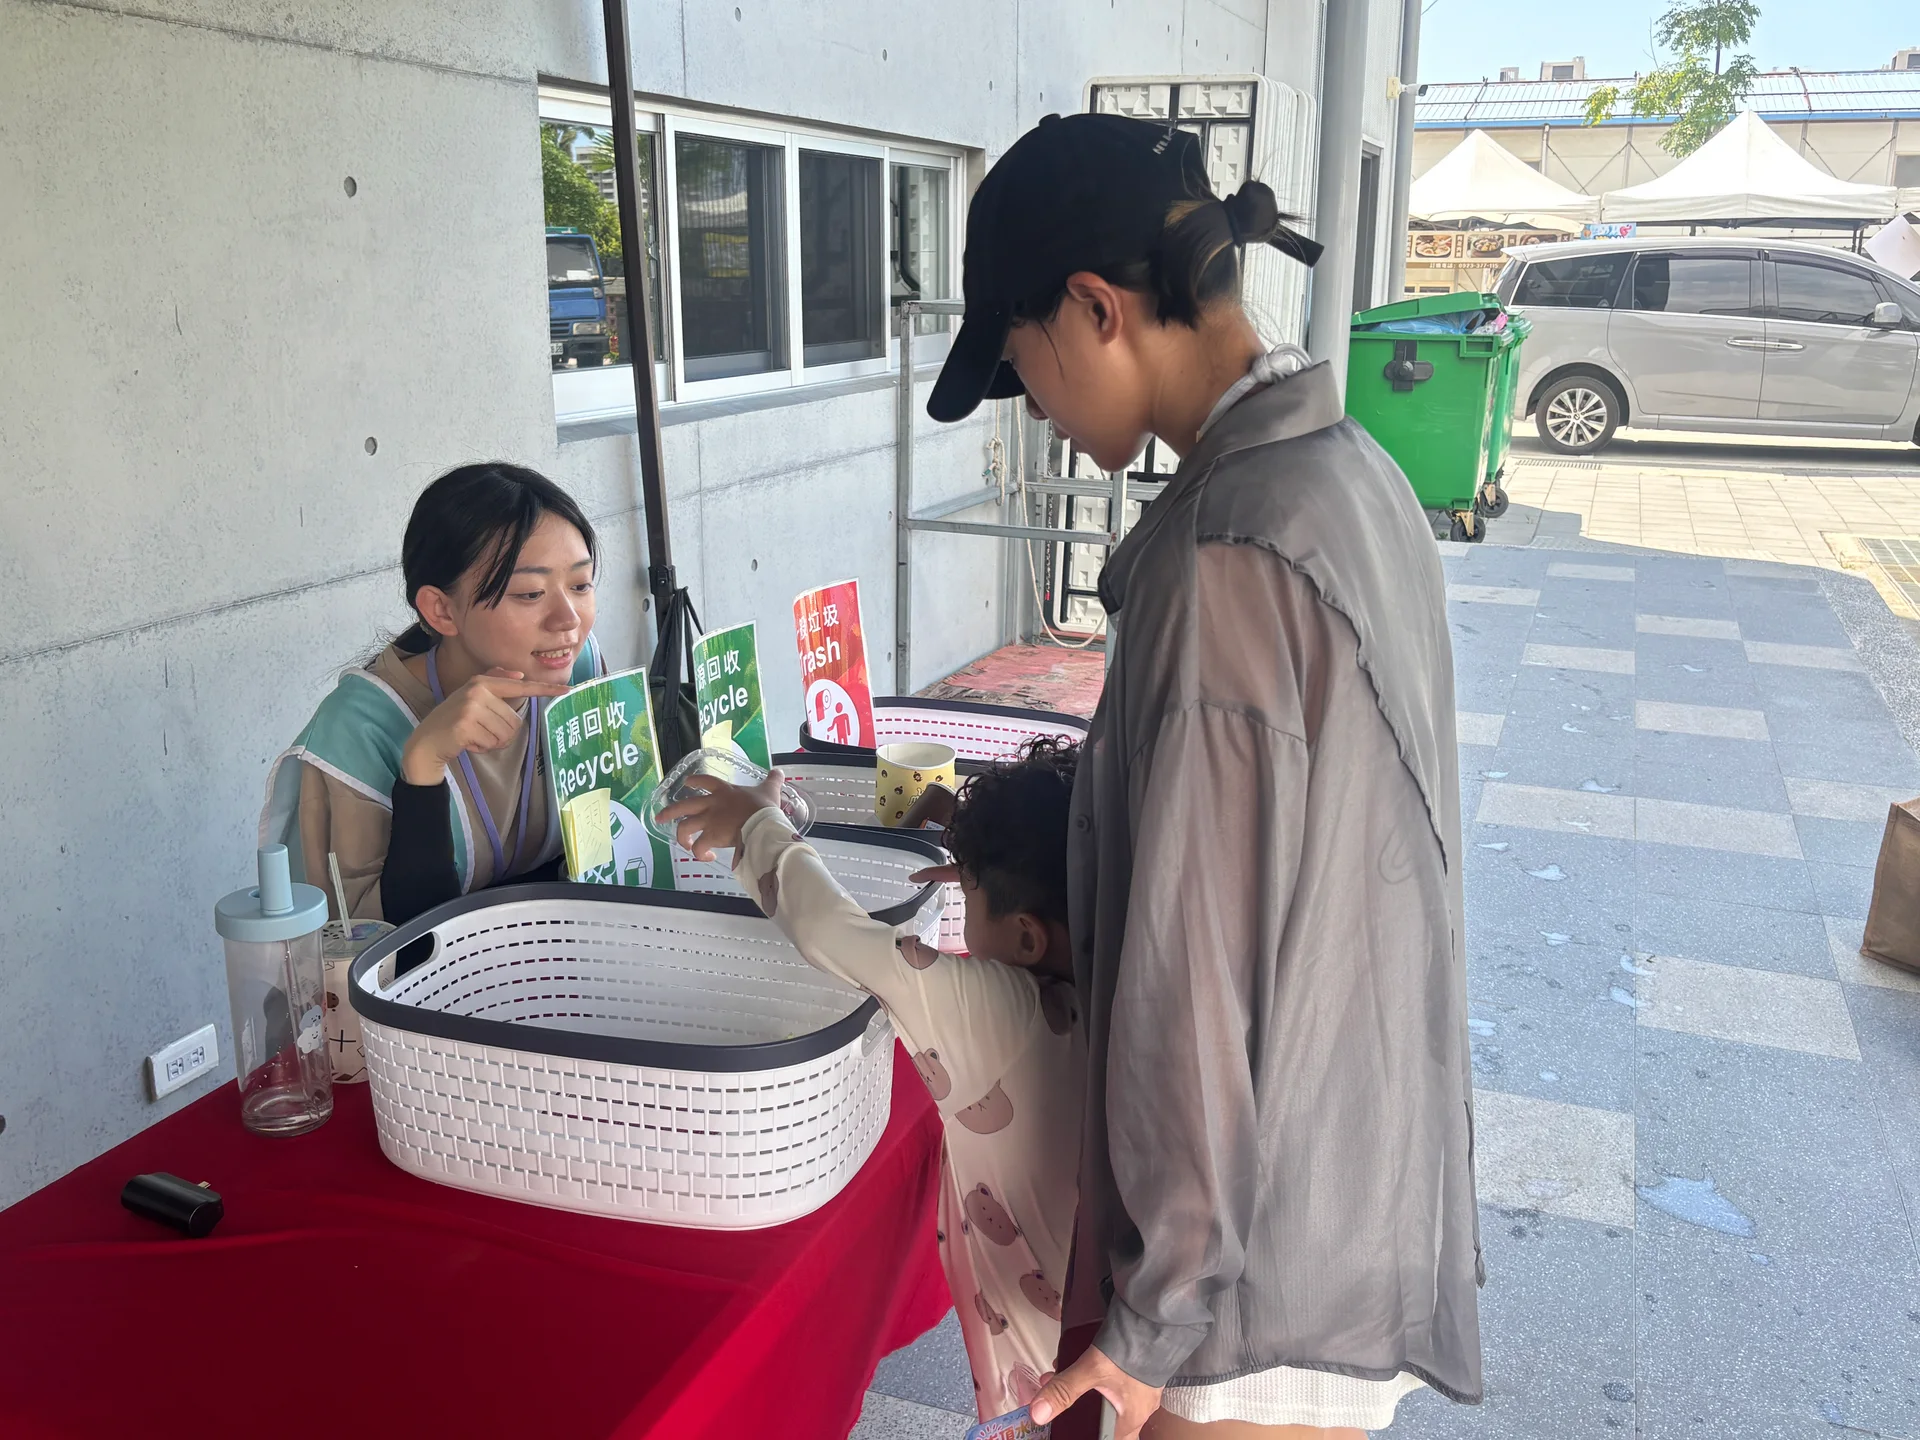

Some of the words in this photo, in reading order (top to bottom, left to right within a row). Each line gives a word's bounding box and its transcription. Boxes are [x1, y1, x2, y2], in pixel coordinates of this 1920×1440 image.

[797, 603, 839, 640] 般垃圾
[696, 649, 741, 691] 源回收
[555, 700, 629, 758] 資源回收
[699, 684, 748, 731] ecycle
[558, 740, 639, 801] Recycle
